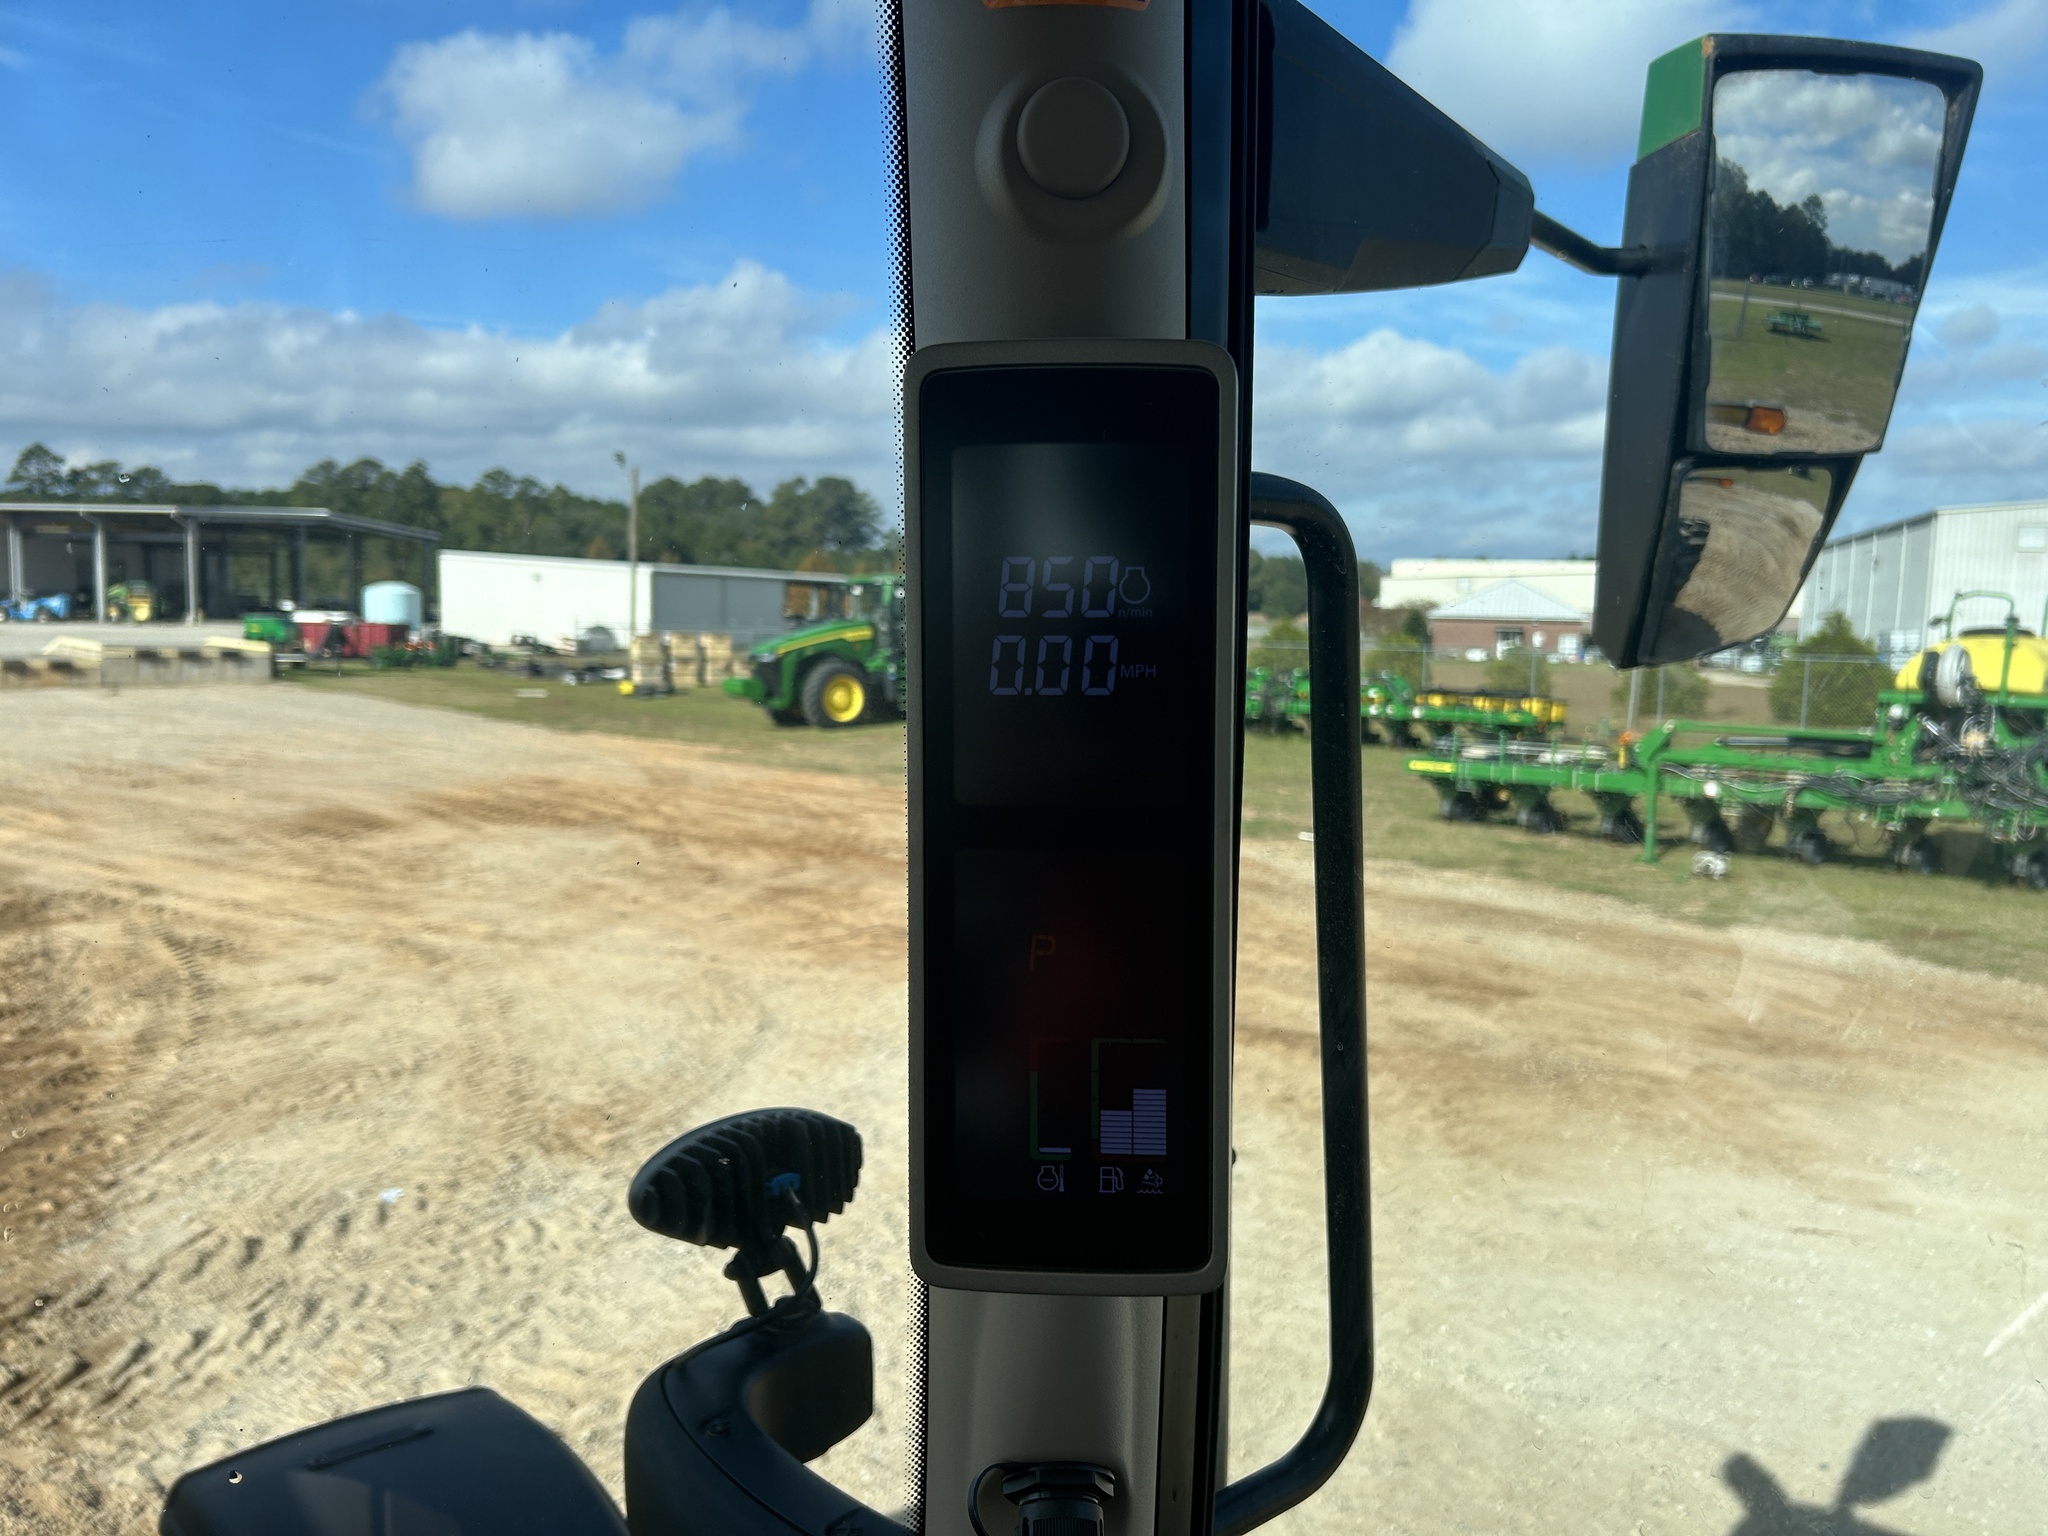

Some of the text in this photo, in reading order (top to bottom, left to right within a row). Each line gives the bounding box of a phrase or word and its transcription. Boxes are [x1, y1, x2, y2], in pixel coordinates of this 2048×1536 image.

[999, 556, 1119, 618] 850
[1118, 608, 1153, 618] n/min
[990, 635, 1157, 696] 0.00 MPH
[1029, 934, 1056, 971] P
